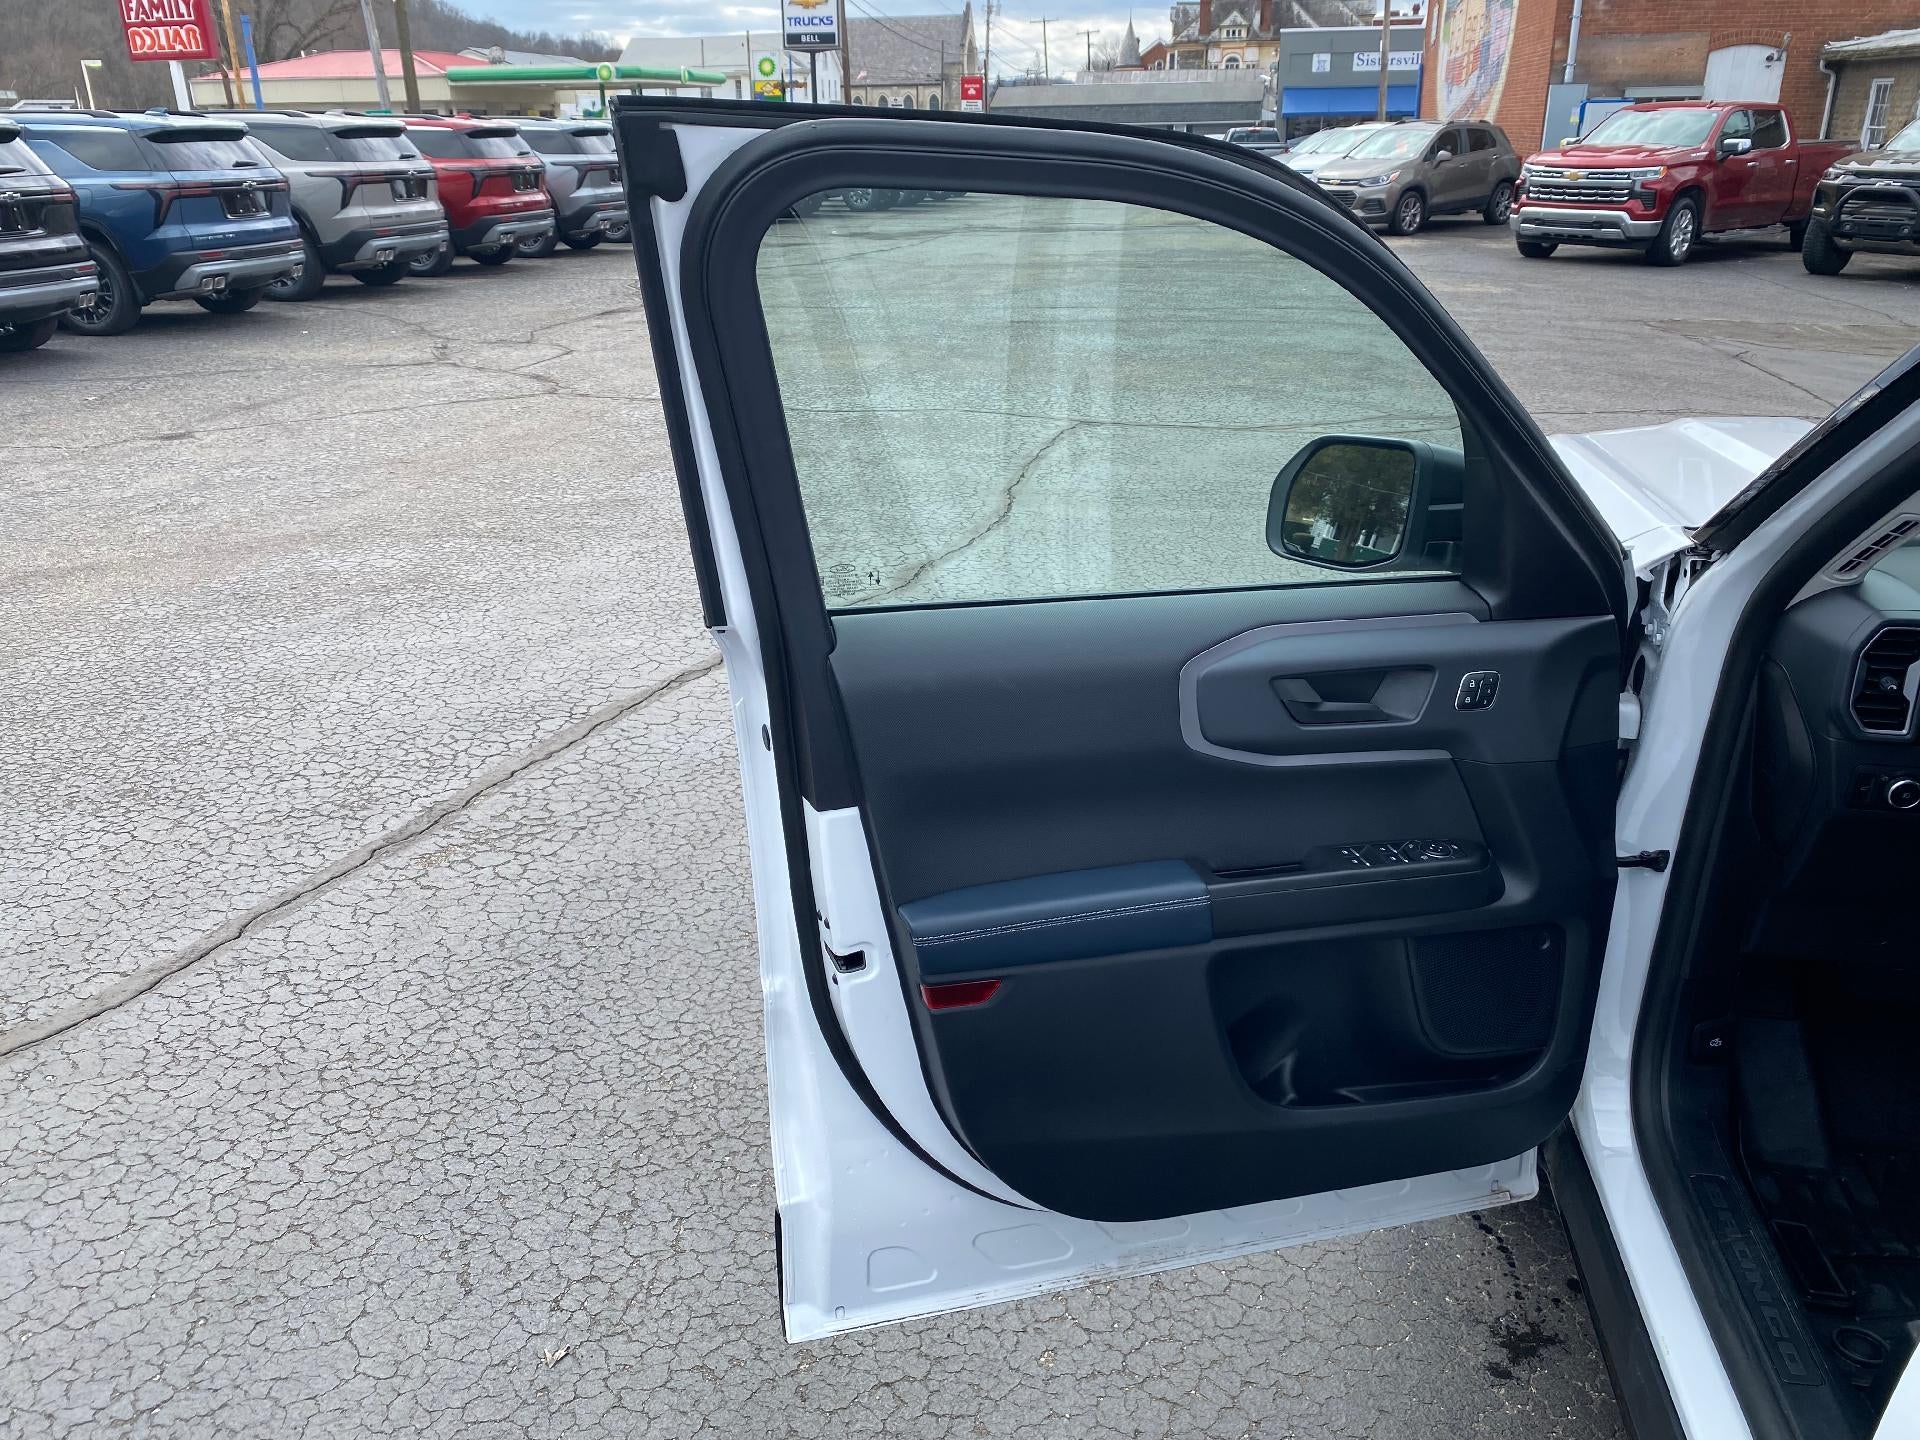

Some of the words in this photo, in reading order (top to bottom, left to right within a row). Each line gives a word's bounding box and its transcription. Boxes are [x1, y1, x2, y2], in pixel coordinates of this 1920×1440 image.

[122, 0, 195, 22] FAMILY
[787, 16, 834, 27] TRUCKS
[128, 24, 203, 53] DOLLAR
[800, 34, 821, 42] BELL
[1356, 52, 1420, 67] Sistrsvil
[1708, 1183, 1807, 1376] BRONCO
